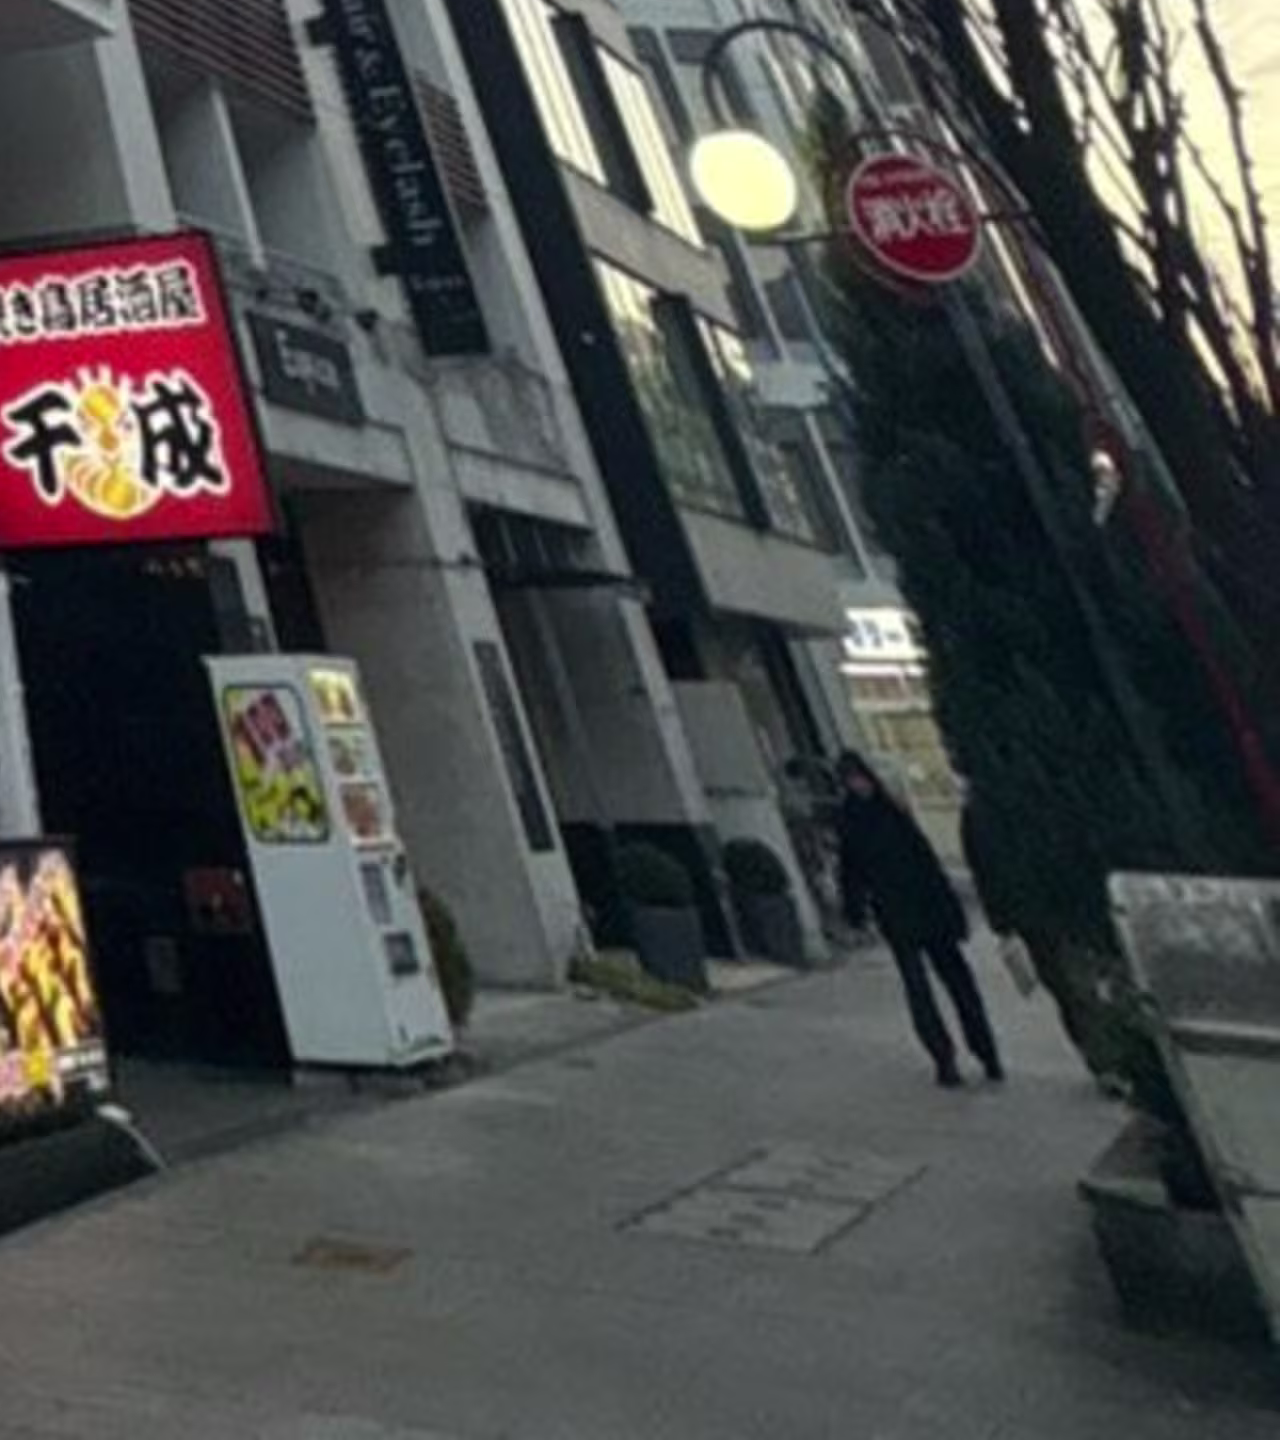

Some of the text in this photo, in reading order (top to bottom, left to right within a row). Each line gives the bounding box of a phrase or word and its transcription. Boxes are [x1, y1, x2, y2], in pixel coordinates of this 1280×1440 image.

[354, 47, 382, 78] &
[368, 84, 444, 248] Eyelash
[2, 368, 230, 502] 千成
